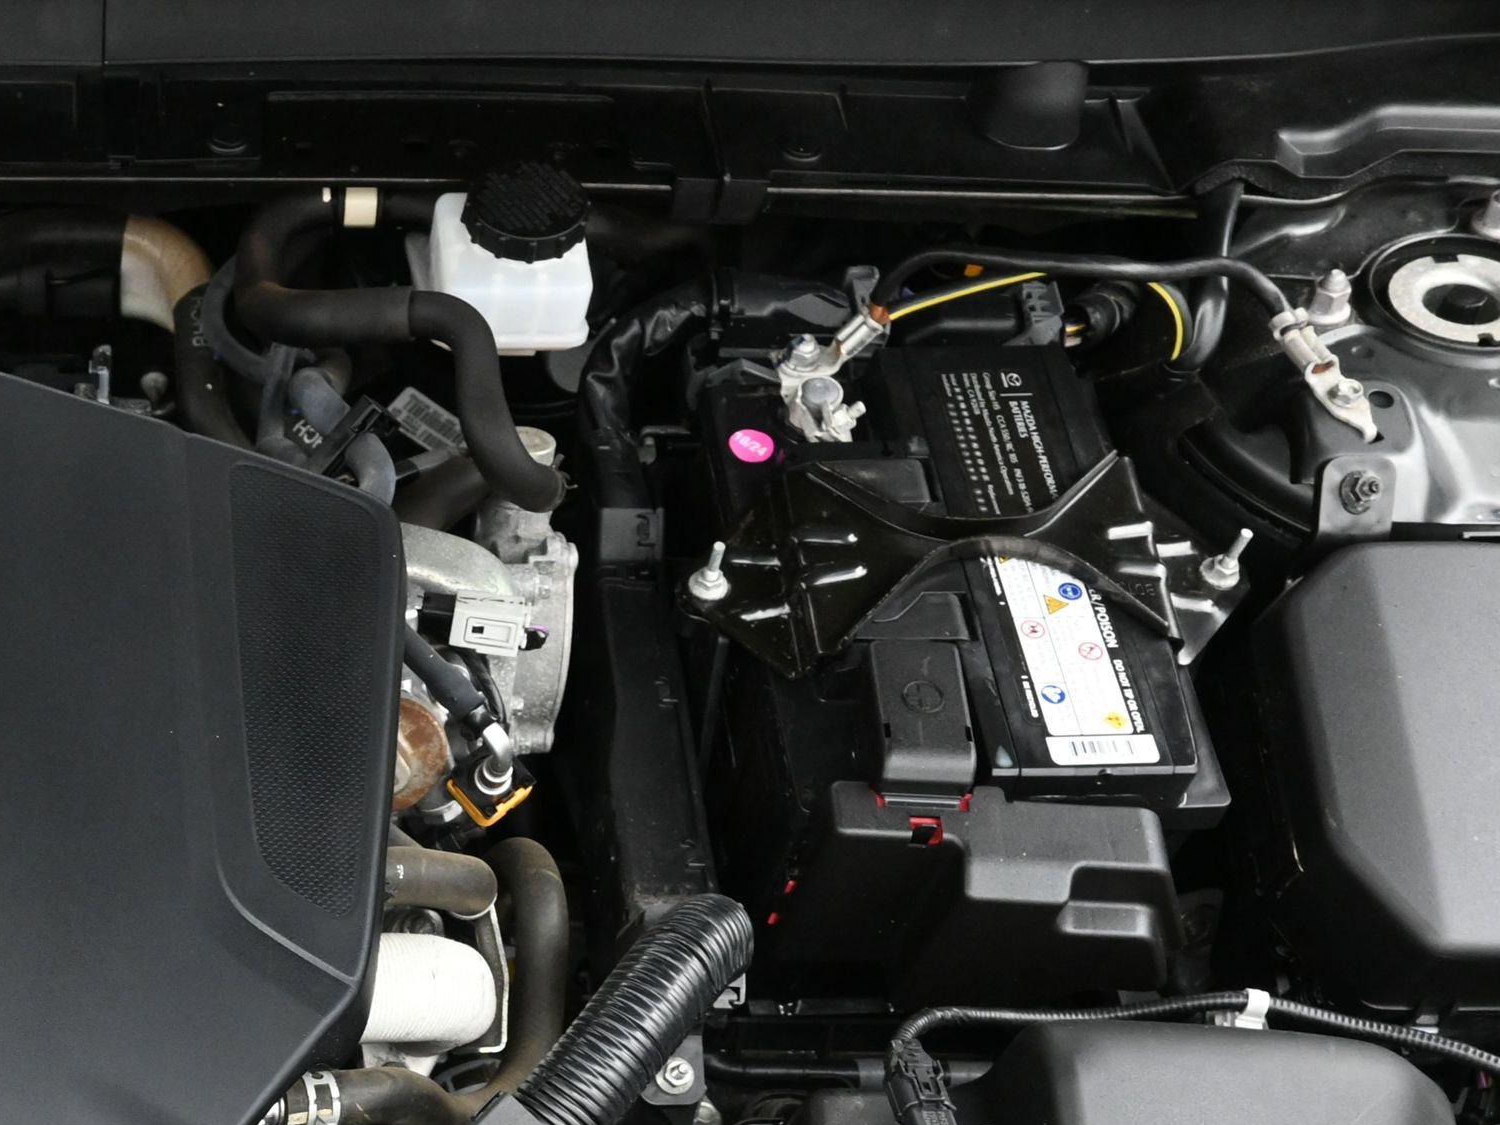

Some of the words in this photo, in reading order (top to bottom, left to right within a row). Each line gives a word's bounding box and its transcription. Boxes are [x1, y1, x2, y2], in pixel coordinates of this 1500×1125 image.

[1009, 401, 1029, 437] BATTERIES
[1020, 401, 1037, 430] MAZDA
[1113, 659, 1124, 670] DO
[1117, 672, 1131, 687] NOT
[1127, 700, 1138, 711] OR
